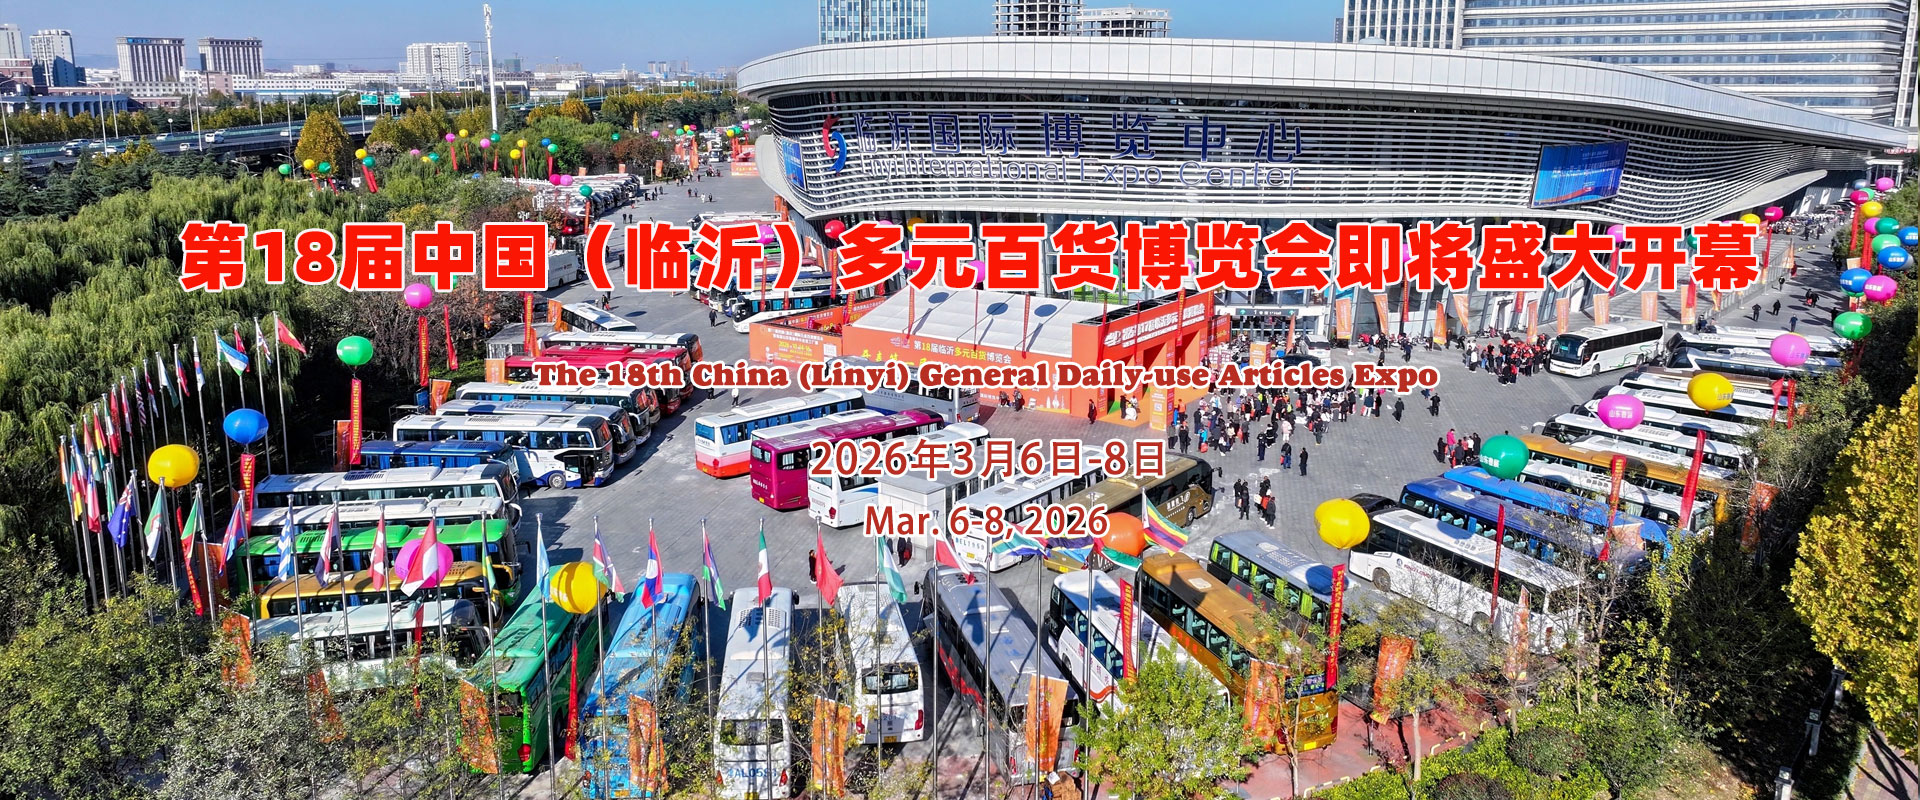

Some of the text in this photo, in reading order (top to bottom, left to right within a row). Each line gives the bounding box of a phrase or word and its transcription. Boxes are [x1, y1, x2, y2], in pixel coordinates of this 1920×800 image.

[854, 112, 1301, 163] 临沂国际博览中心
[903, 152, 1067, 183] International
[1080, 157, 1163, 190] Expo
[1178, 160, 1300, 187] Center
